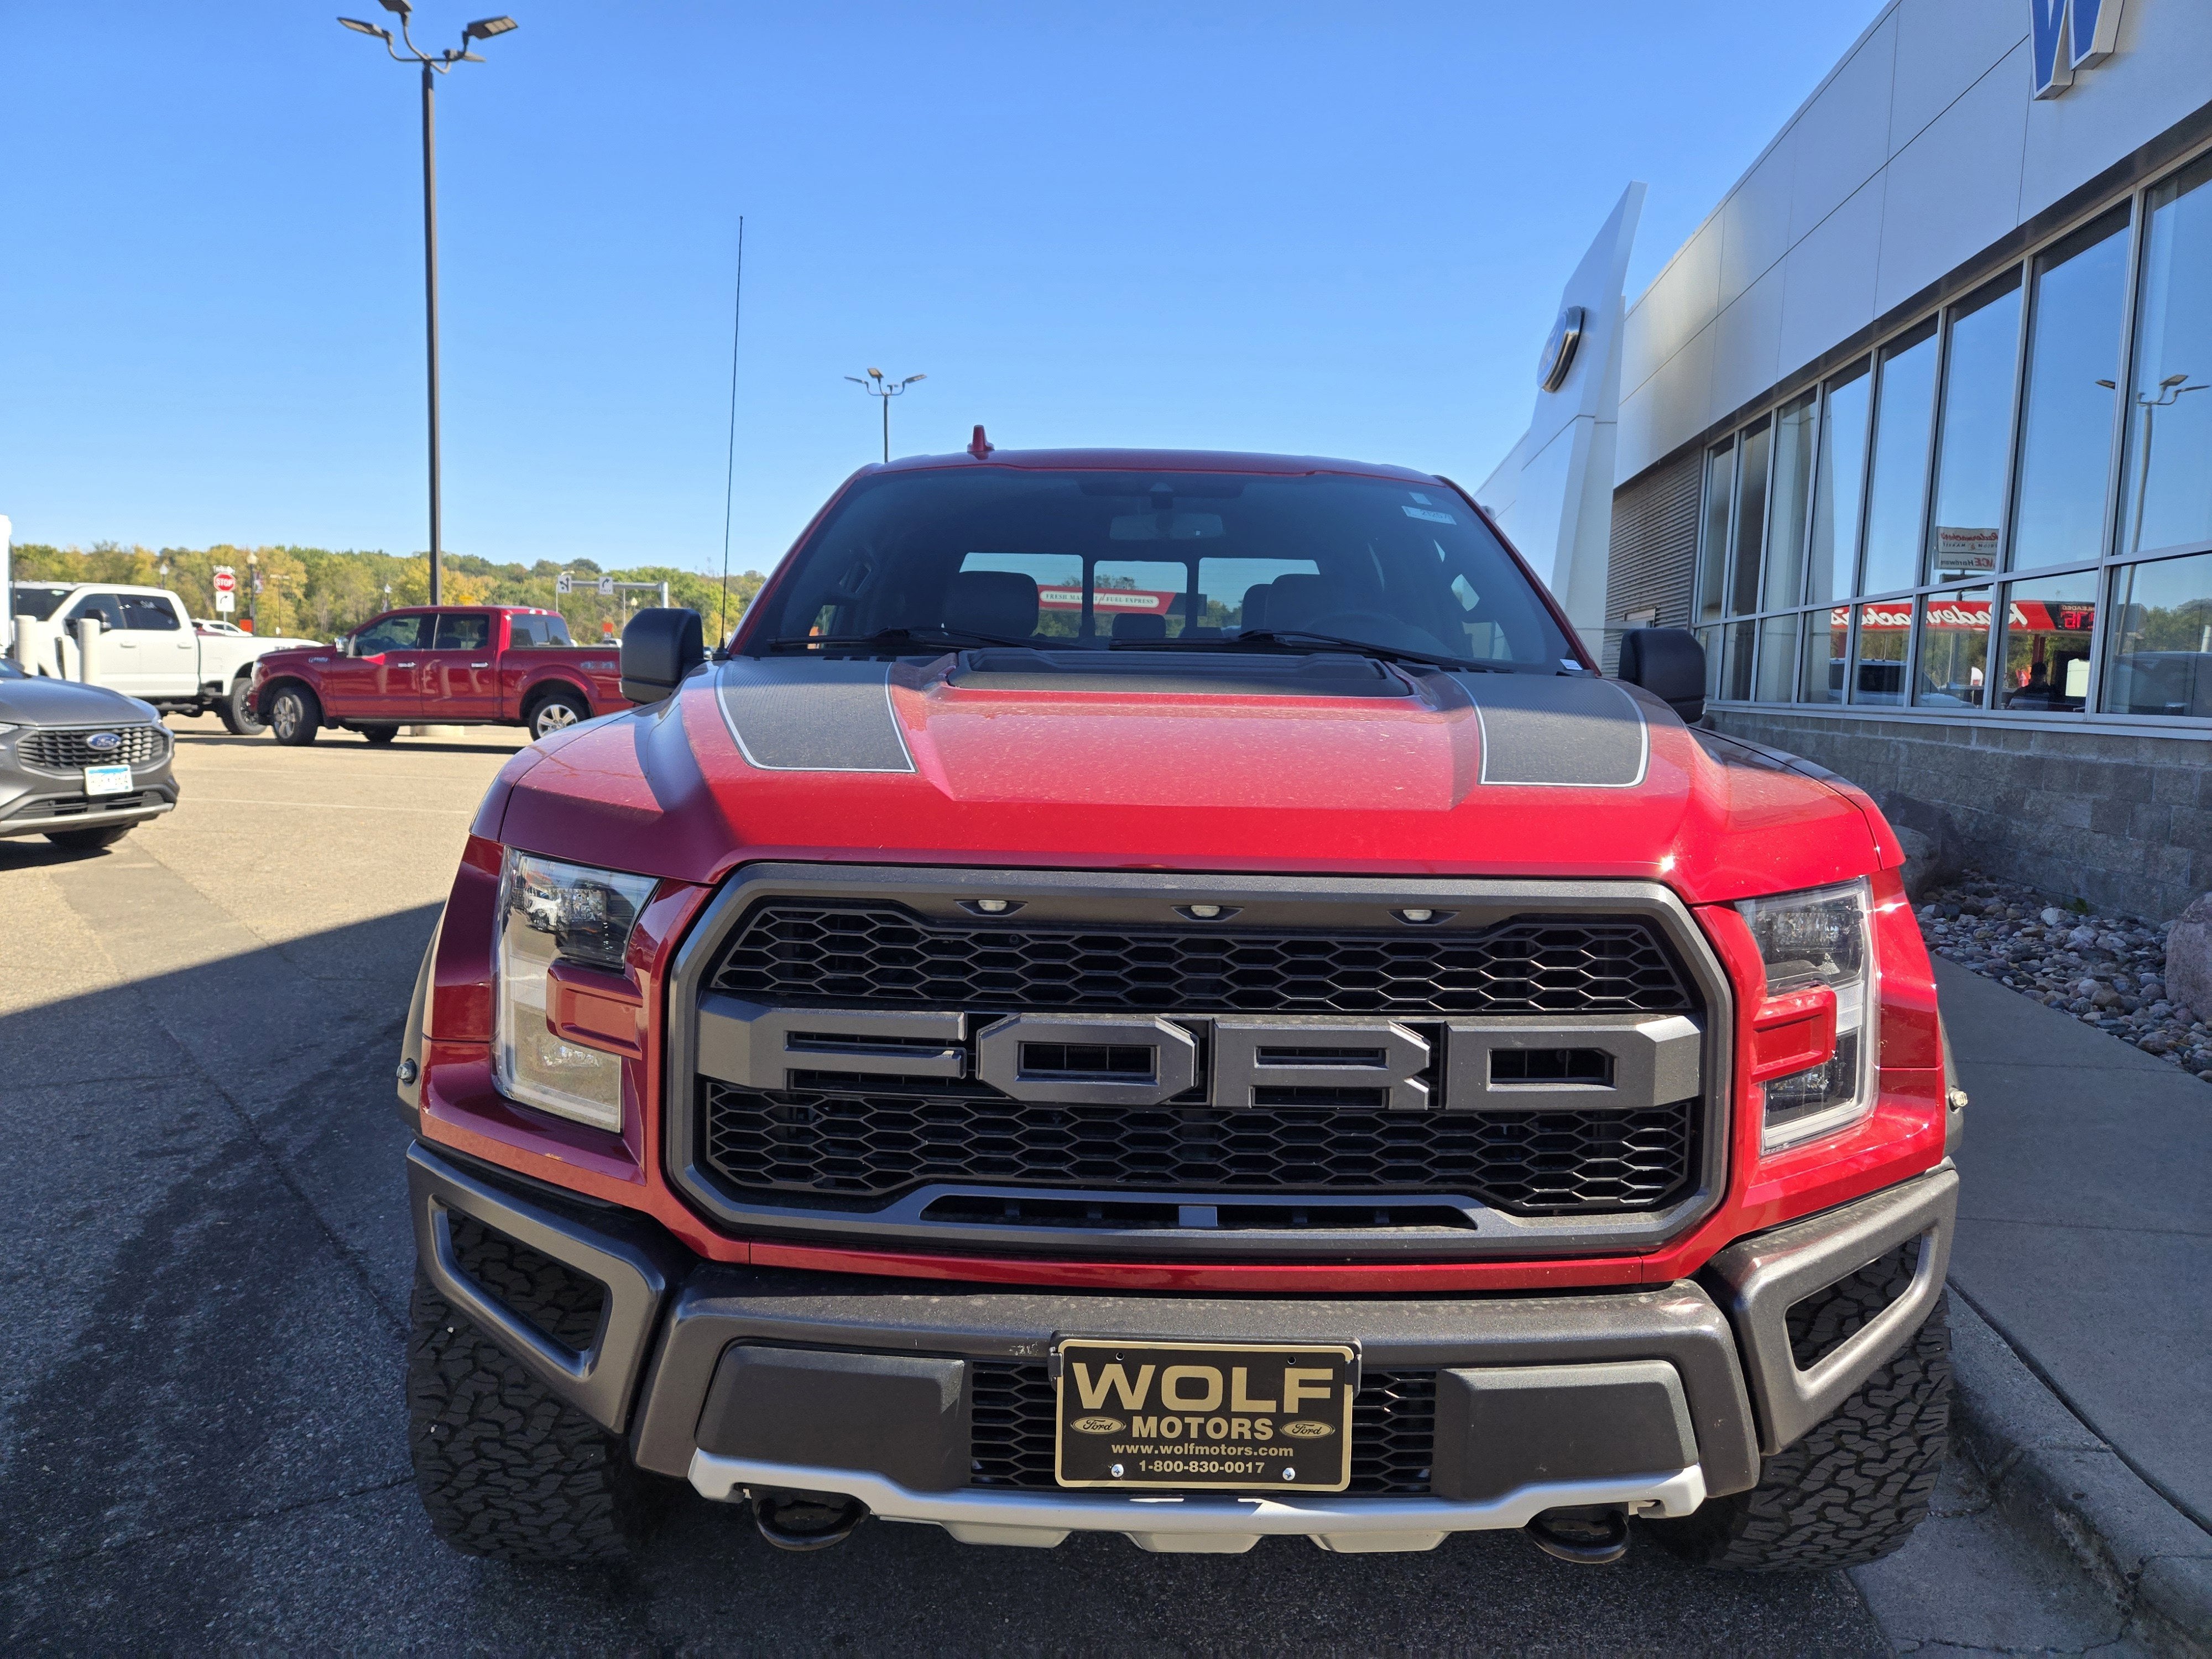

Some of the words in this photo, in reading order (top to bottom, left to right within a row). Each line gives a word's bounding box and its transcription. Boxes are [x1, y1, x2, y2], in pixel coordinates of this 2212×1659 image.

[216, 578, 233, 587] STOP
[698, 1010, 1704, 1110] FORD
[1072, 1362, 1333, 1413] WOLF
[1083, 1420, 1113, 1431] Ford
[1132, 1416, 1274, 1441] MOTORS
[1292, 1423, 1322, 1434] Ford
[1111, 1442, 1294, 1457] www.wolfmotors.com
[1139, 1460, 1265, 1474] 1-800-830-0017
